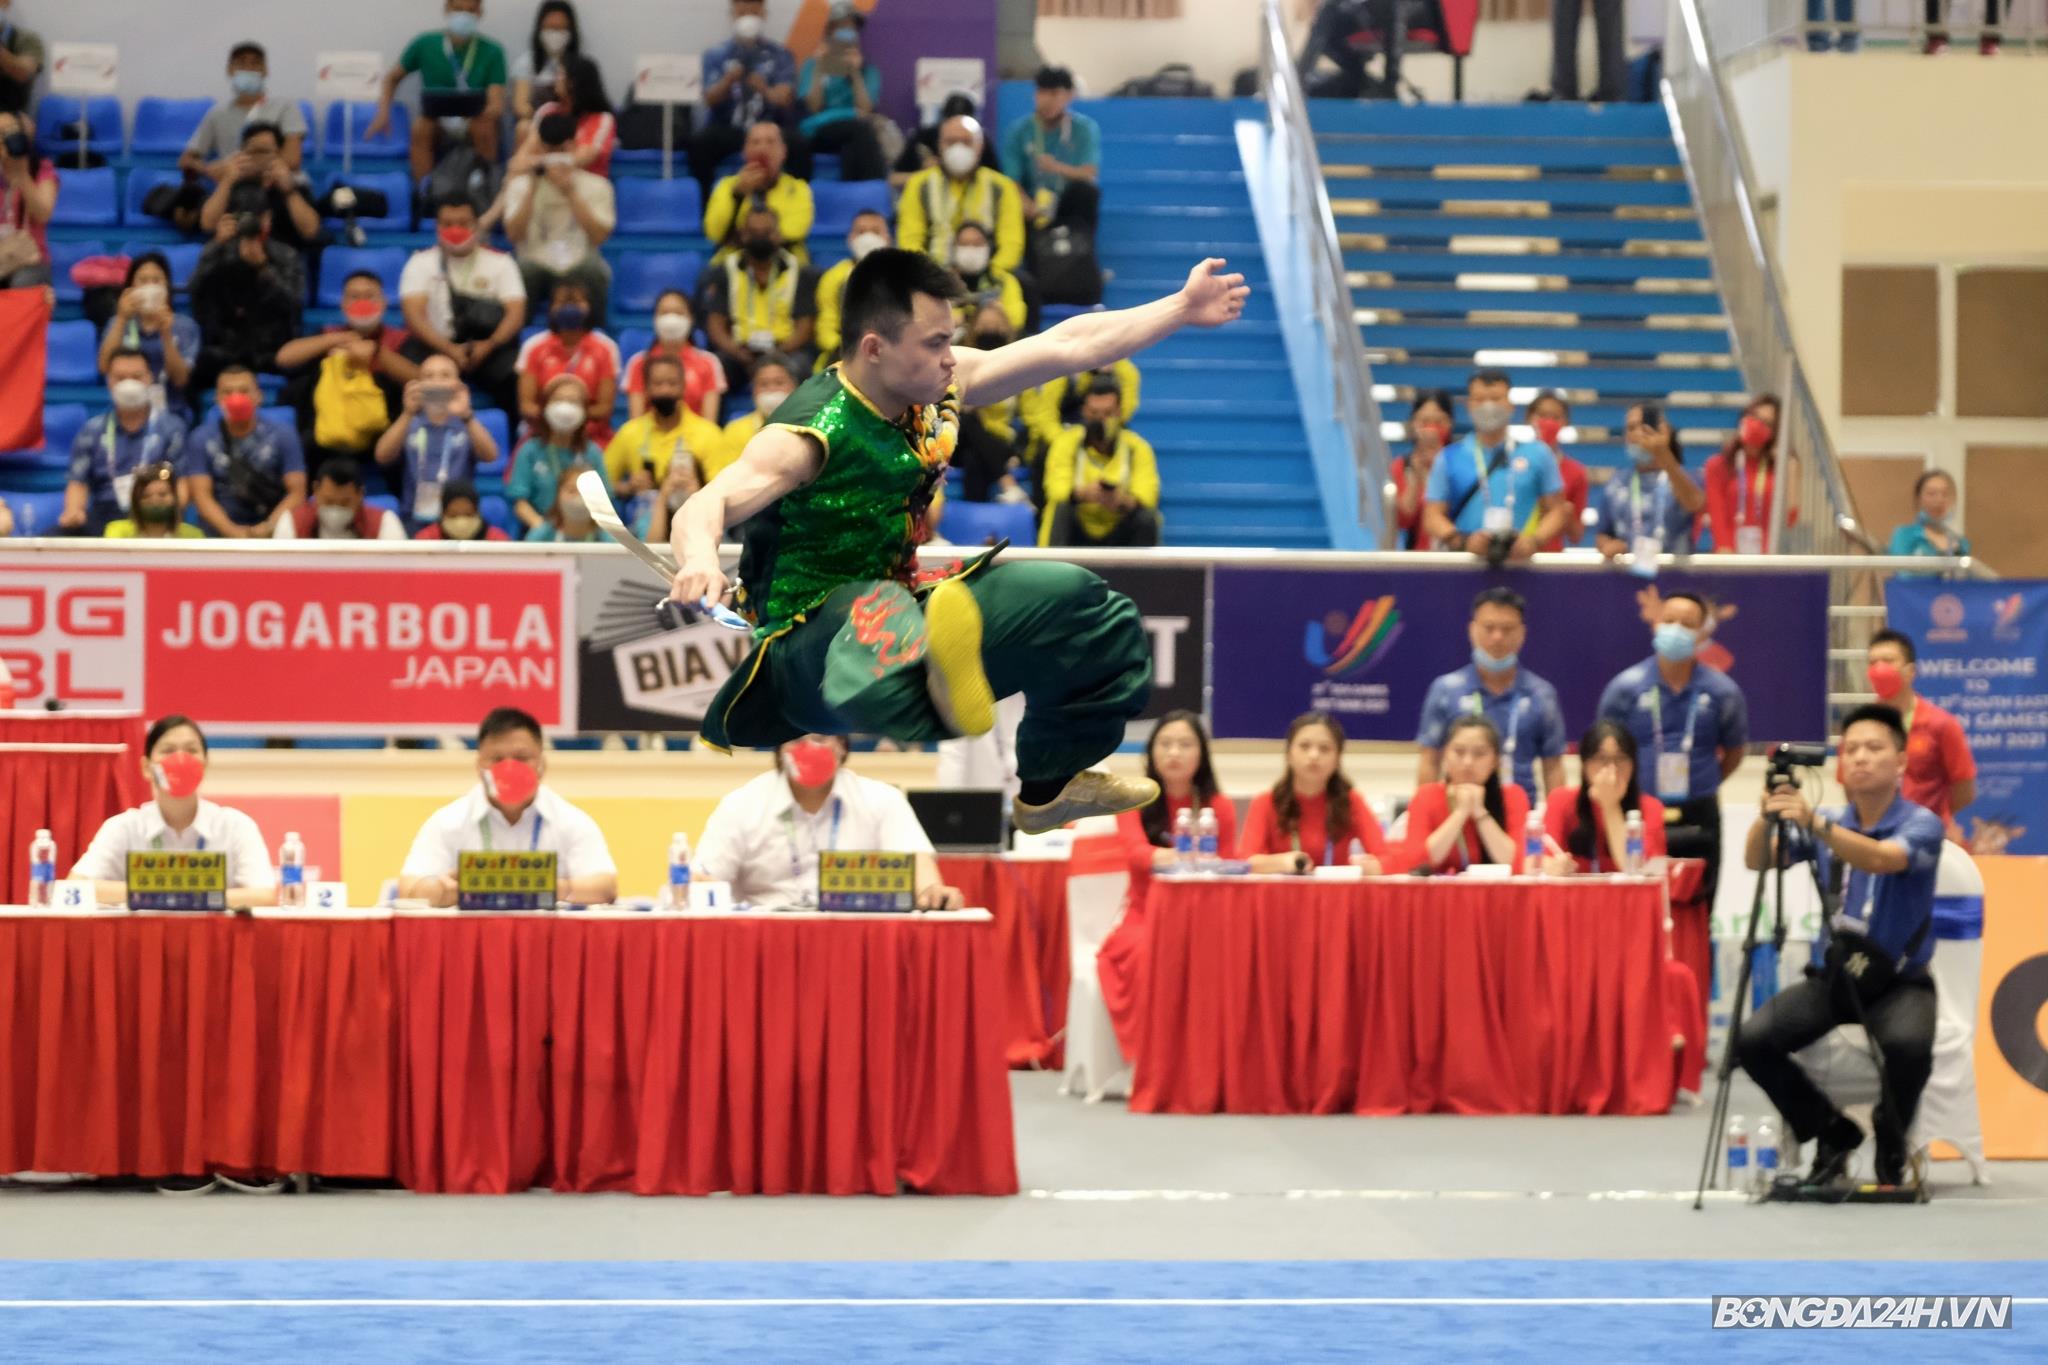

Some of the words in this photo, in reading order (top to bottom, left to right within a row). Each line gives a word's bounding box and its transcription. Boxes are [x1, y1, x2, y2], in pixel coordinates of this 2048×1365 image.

[161, 599, 554, 651] JOGARBOLA
[390, 655, 554, 688] JAPAN
[631, 643, 715, 692] BIA
[1918, 656, 2037, 678] WELCOME
[1965, 678, 1991, 692] TO
[317, 888, 333, 908] 2
